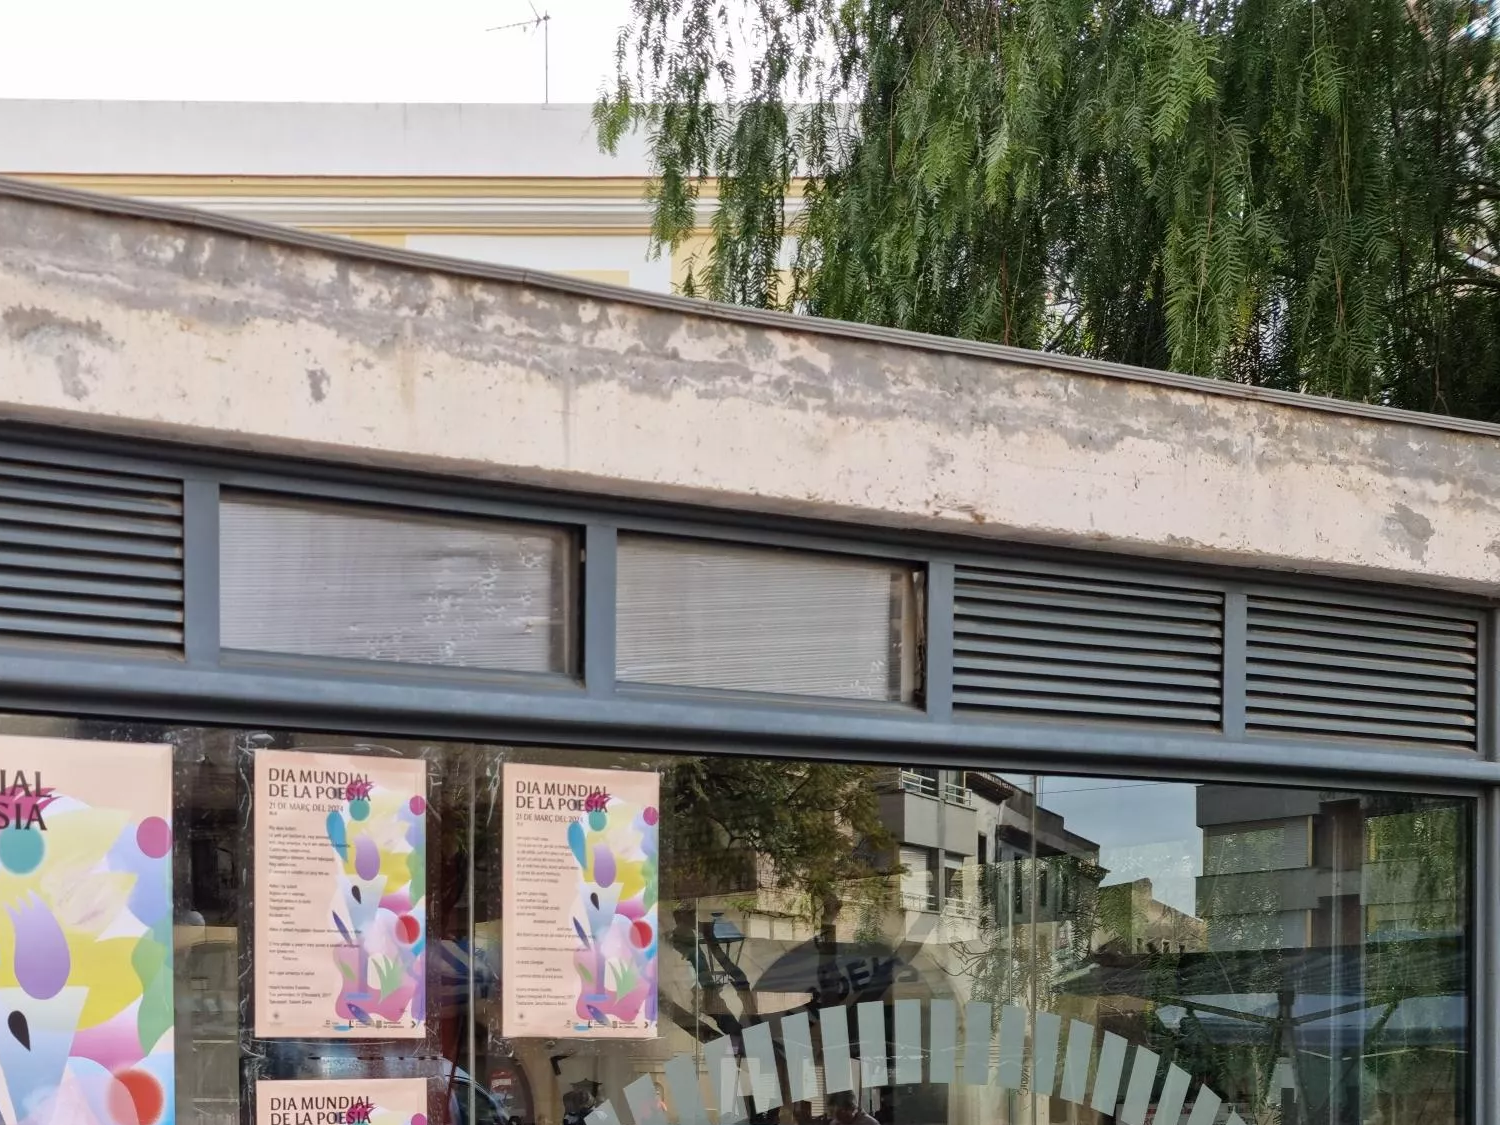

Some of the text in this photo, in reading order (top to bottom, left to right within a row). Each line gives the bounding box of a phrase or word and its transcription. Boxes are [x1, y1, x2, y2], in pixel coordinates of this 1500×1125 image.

[269, 768, 369, 784] DIA MUNDIAL
[269, 784, 371, 801] DE LA POESIA
[516, 781, 606, 797] DIA MUNDIAL
[516, 796, 607, 812] DE LA POESIA
[271, 1096, 370, 1110] DIA MUNDIAL
[271, 1111, 371, 1125] DE LA POESIA
